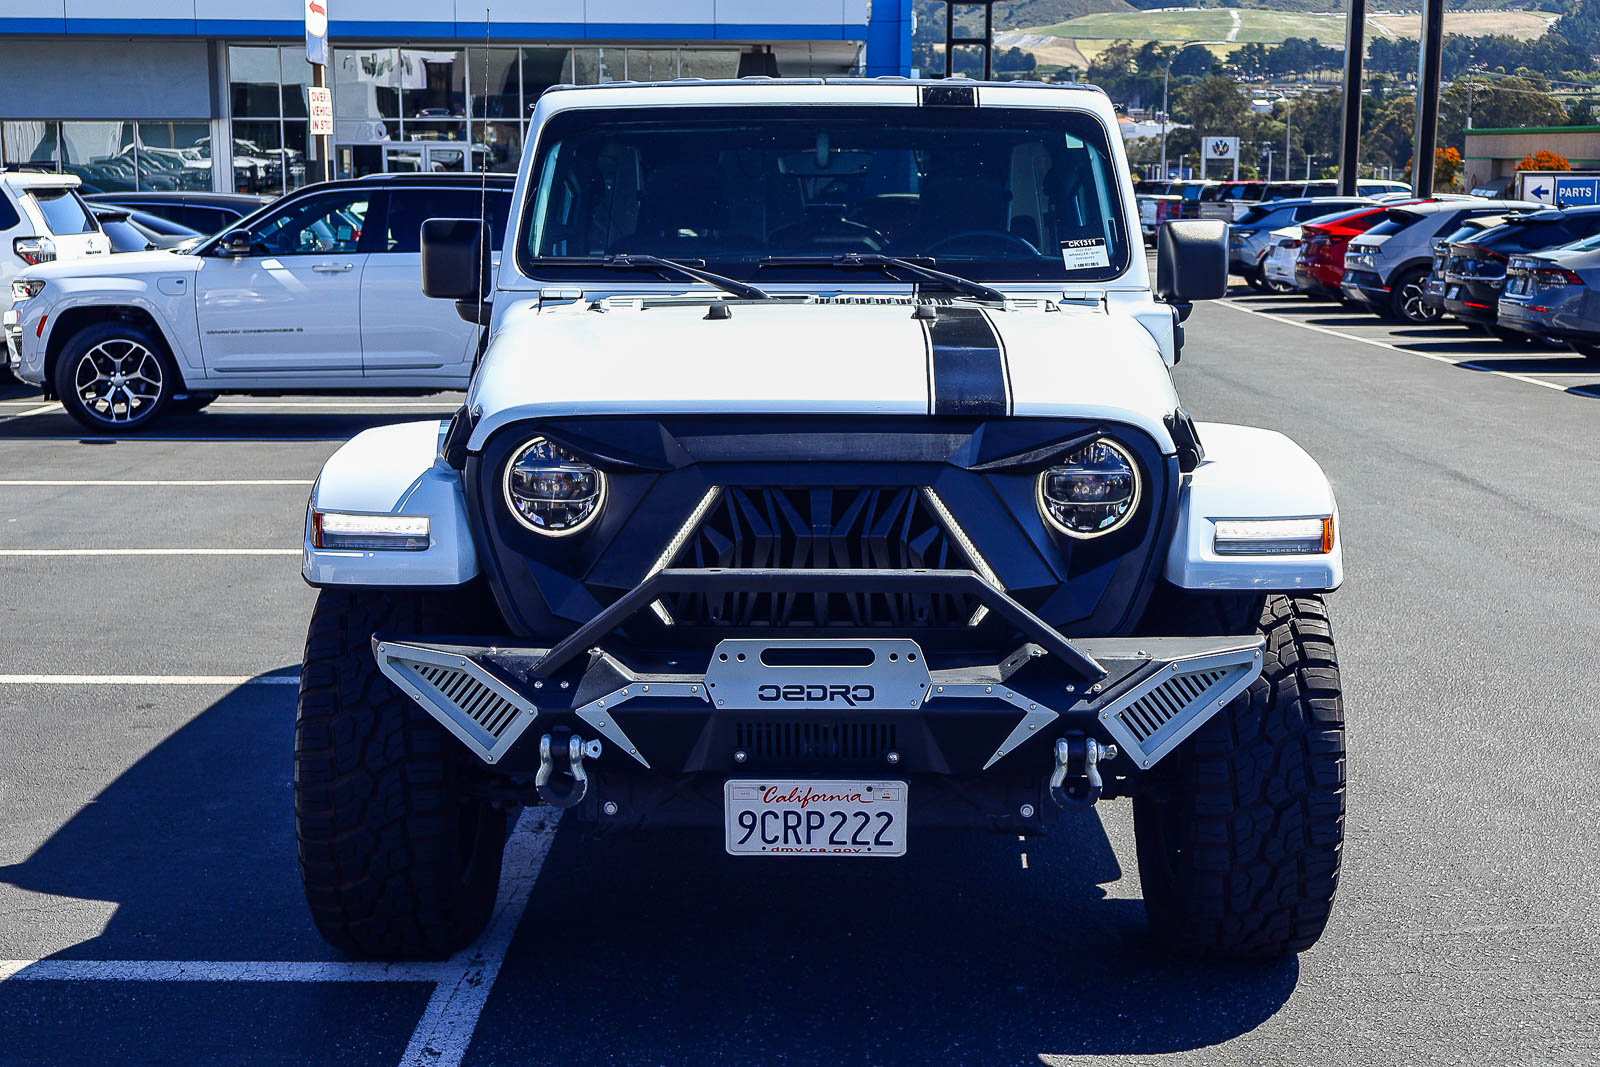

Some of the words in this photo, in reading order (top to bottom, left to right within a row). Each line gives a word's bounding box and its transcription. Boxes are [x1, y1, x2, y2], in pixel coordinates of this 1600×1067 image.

[312, 120, 319, 130] IN
[1559, 187, 1592, 198] PARTS
[1068, 239, 1096, 248] CK1311
[762, 785, 875, 809] California
[737, 810, 894, 846] 9CRP222
[770, 846, 863, 854] dmv.ca.gov
